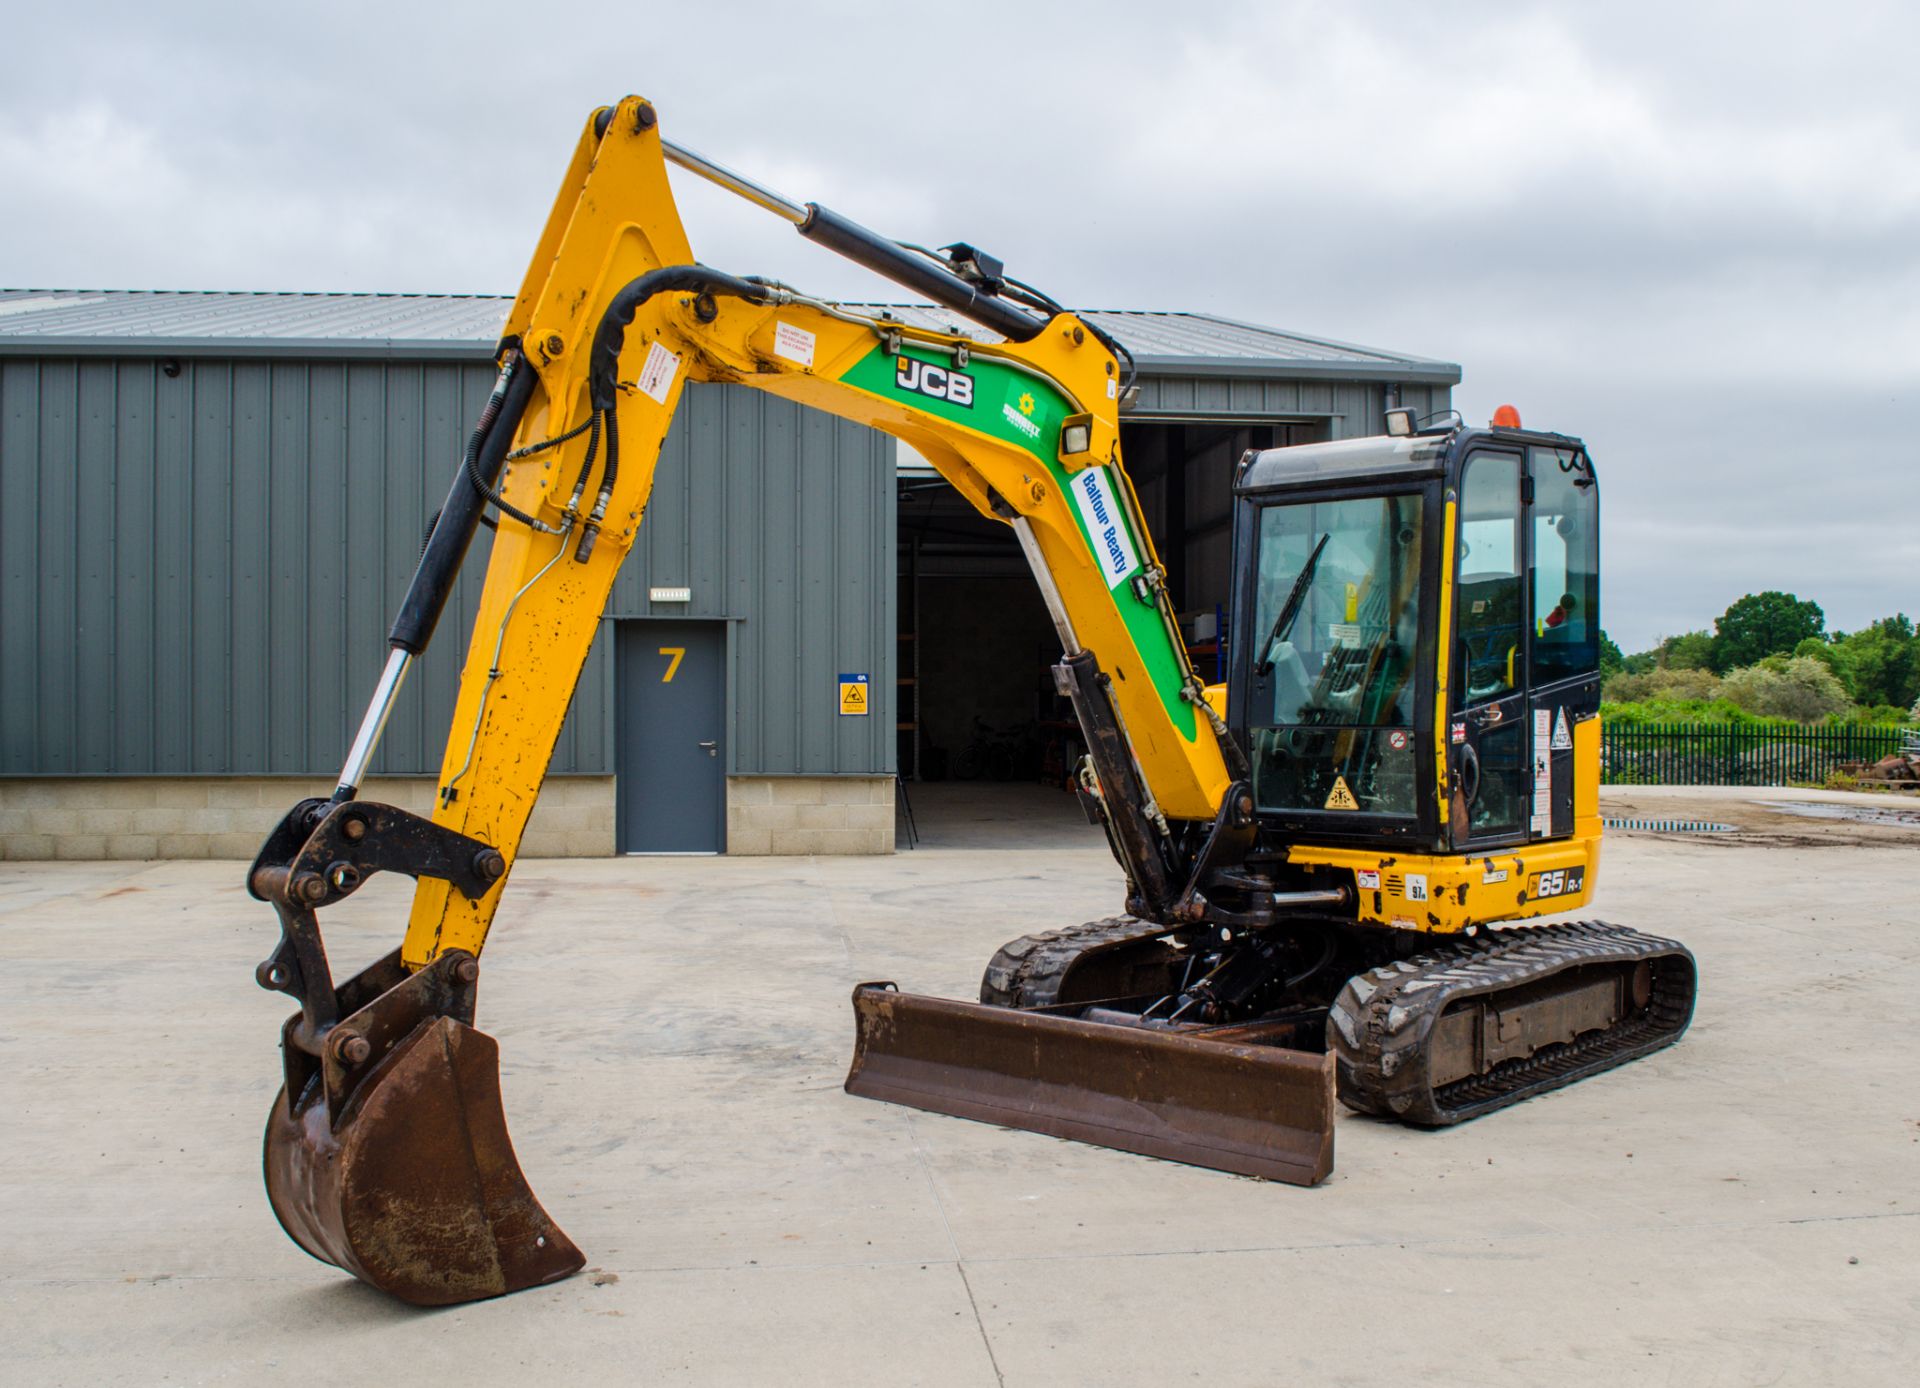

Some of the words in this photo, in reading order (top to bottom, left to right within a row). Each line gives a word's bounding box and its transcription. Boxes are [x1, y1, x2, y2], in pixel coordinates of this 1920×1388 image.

[897, 360, 973, 405] JCB
[1082, 472, 1110, 526] Balfour
[1103, 525, 1128, 574] Beatty
[659, 647, 686, 683] 7
[1412, 886, 1422, 899] 97
[1538, 871, 1565, 897] 65
